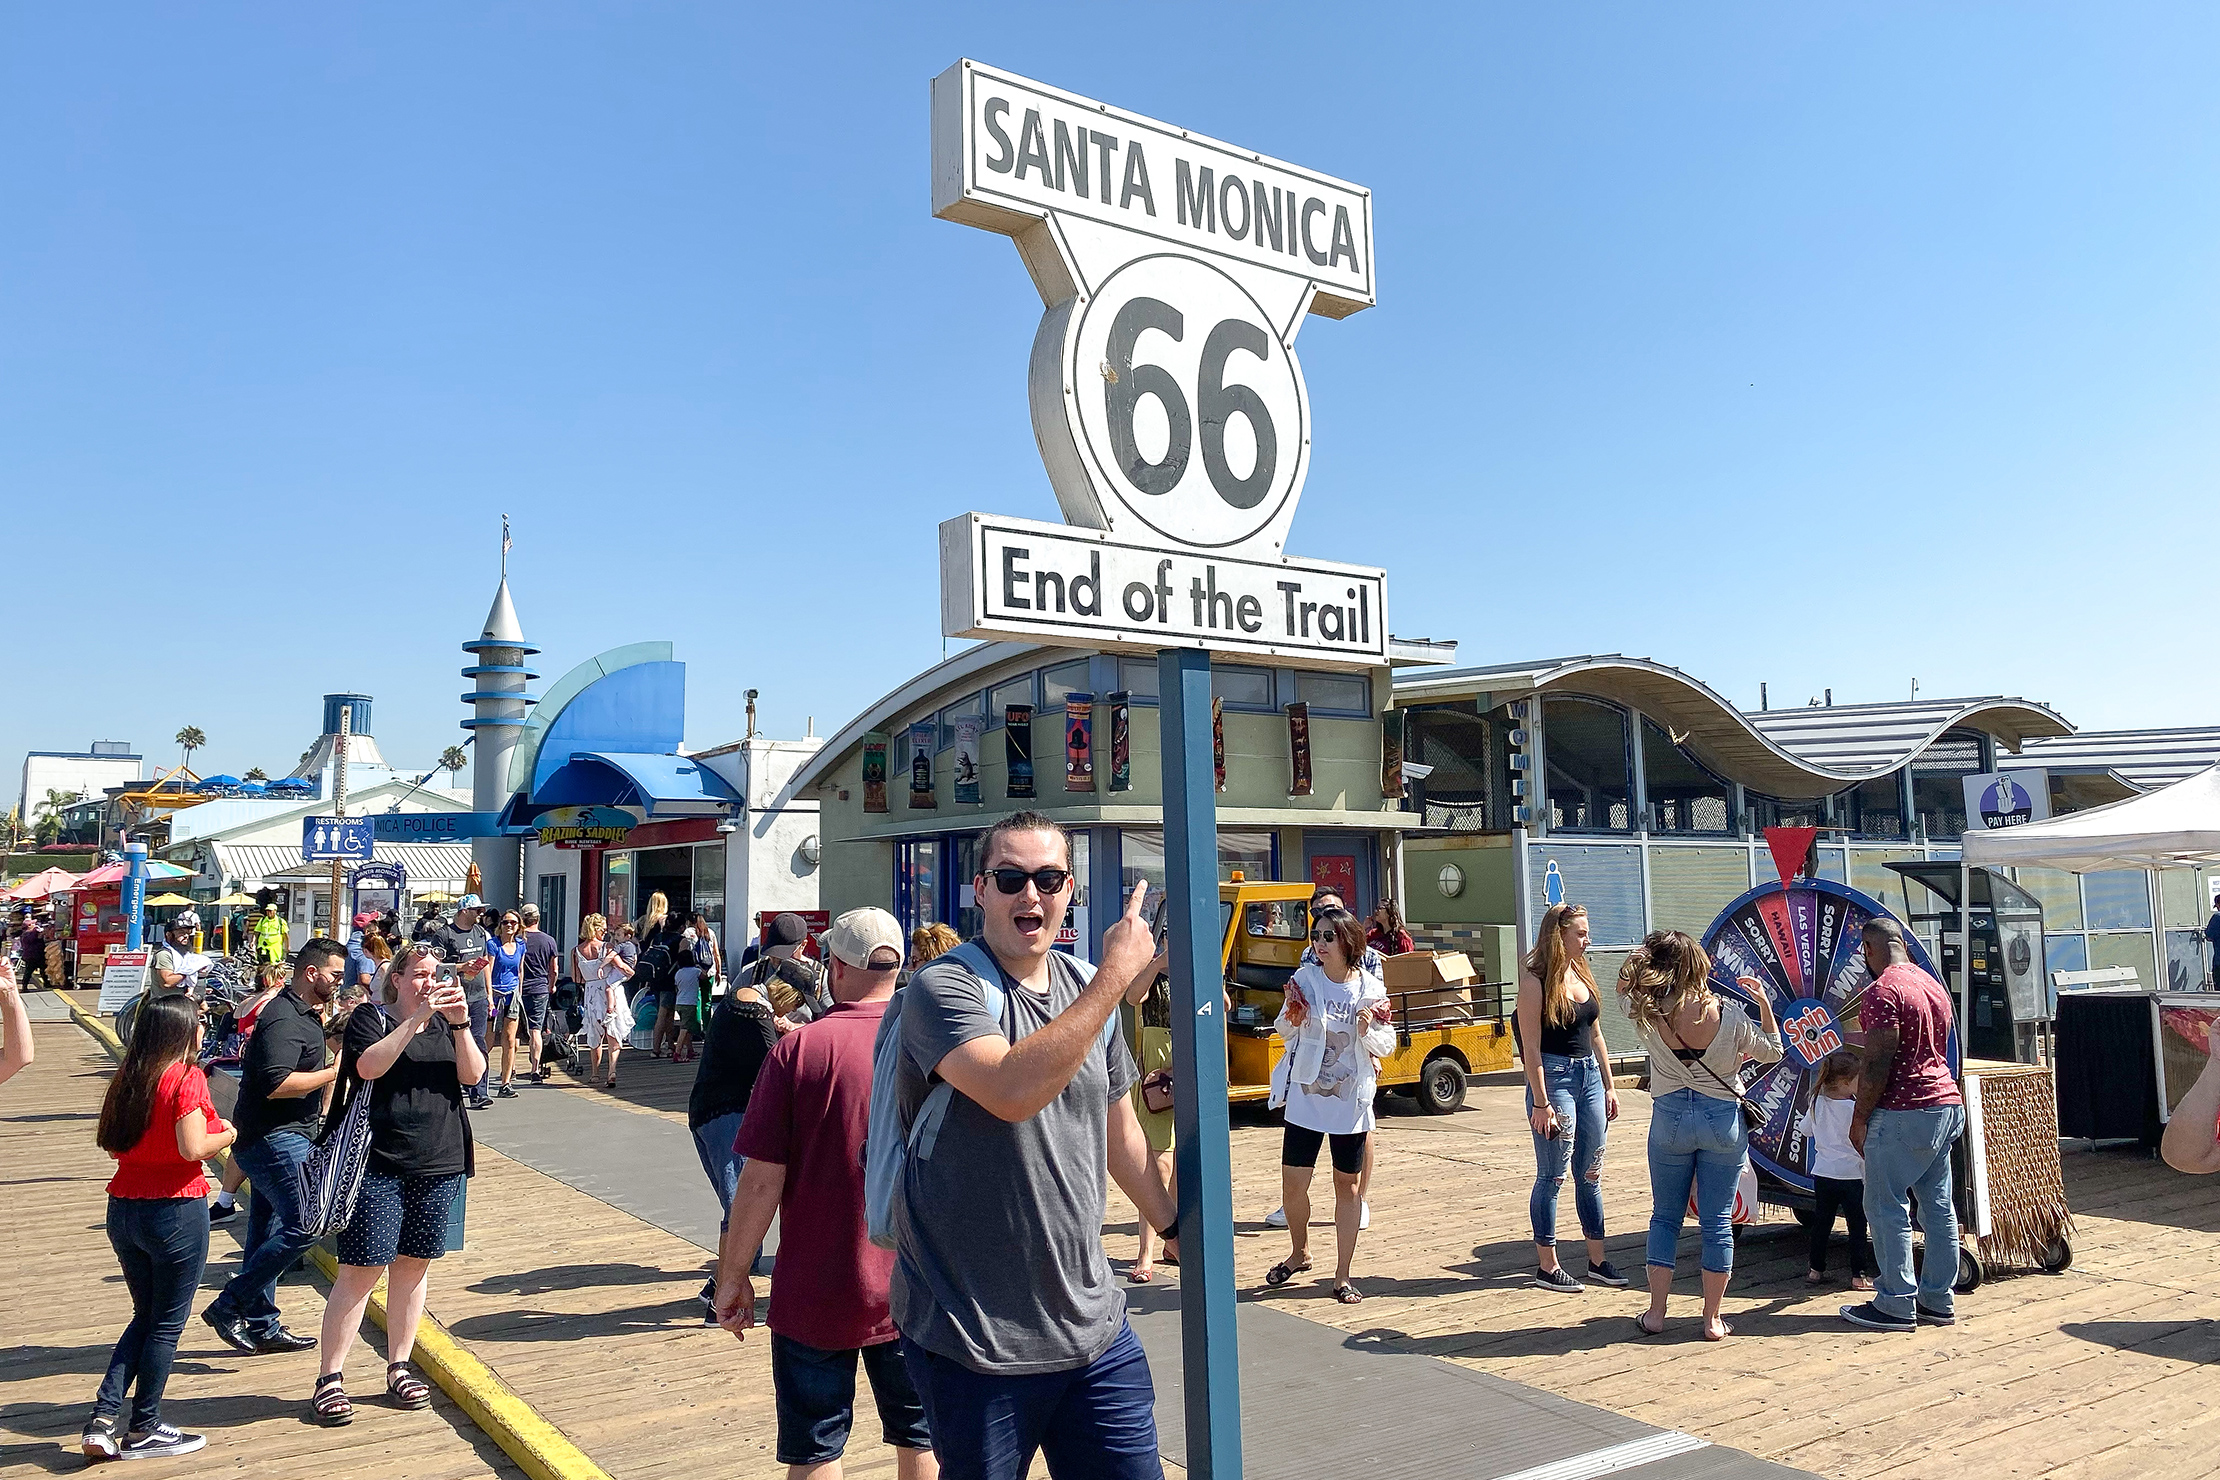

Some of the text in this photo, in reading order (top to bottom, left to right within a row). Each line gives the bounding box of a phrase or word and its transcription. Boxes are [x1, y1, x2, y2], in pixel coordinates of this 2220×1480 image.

[983, 96, 1360, 275] SANTA MONICA
[1103, 296, 1278, 510] 66
[1002, 545, 1370, 644] End of the Trail
[1006, 711, 1030, 722] UFO
[1507, 702, 1530, 822] WOMEN
[315, 818, 364, 826] RESTROOMS
[403, 817, 456, 832] POLICE
[541, 827, 627, 845] BLAZING SADDLES
[1987, 814, 2027, 827] PAY HERE
[130, 878, 142, 925] Emergency
[1744, 917, 1778, 965] SORRY
[1771, 911, 1793, 959] HAWAII
[1797, 906, 1812, 976] LAS VEGAS
[1819, 903, 1835, 960] SORRY
[1784, 1005, 1833, 1044] Spin
[1796, 1028, 1842, 1066] Win
[1788, 1109, 1805, 1163] SORRY
